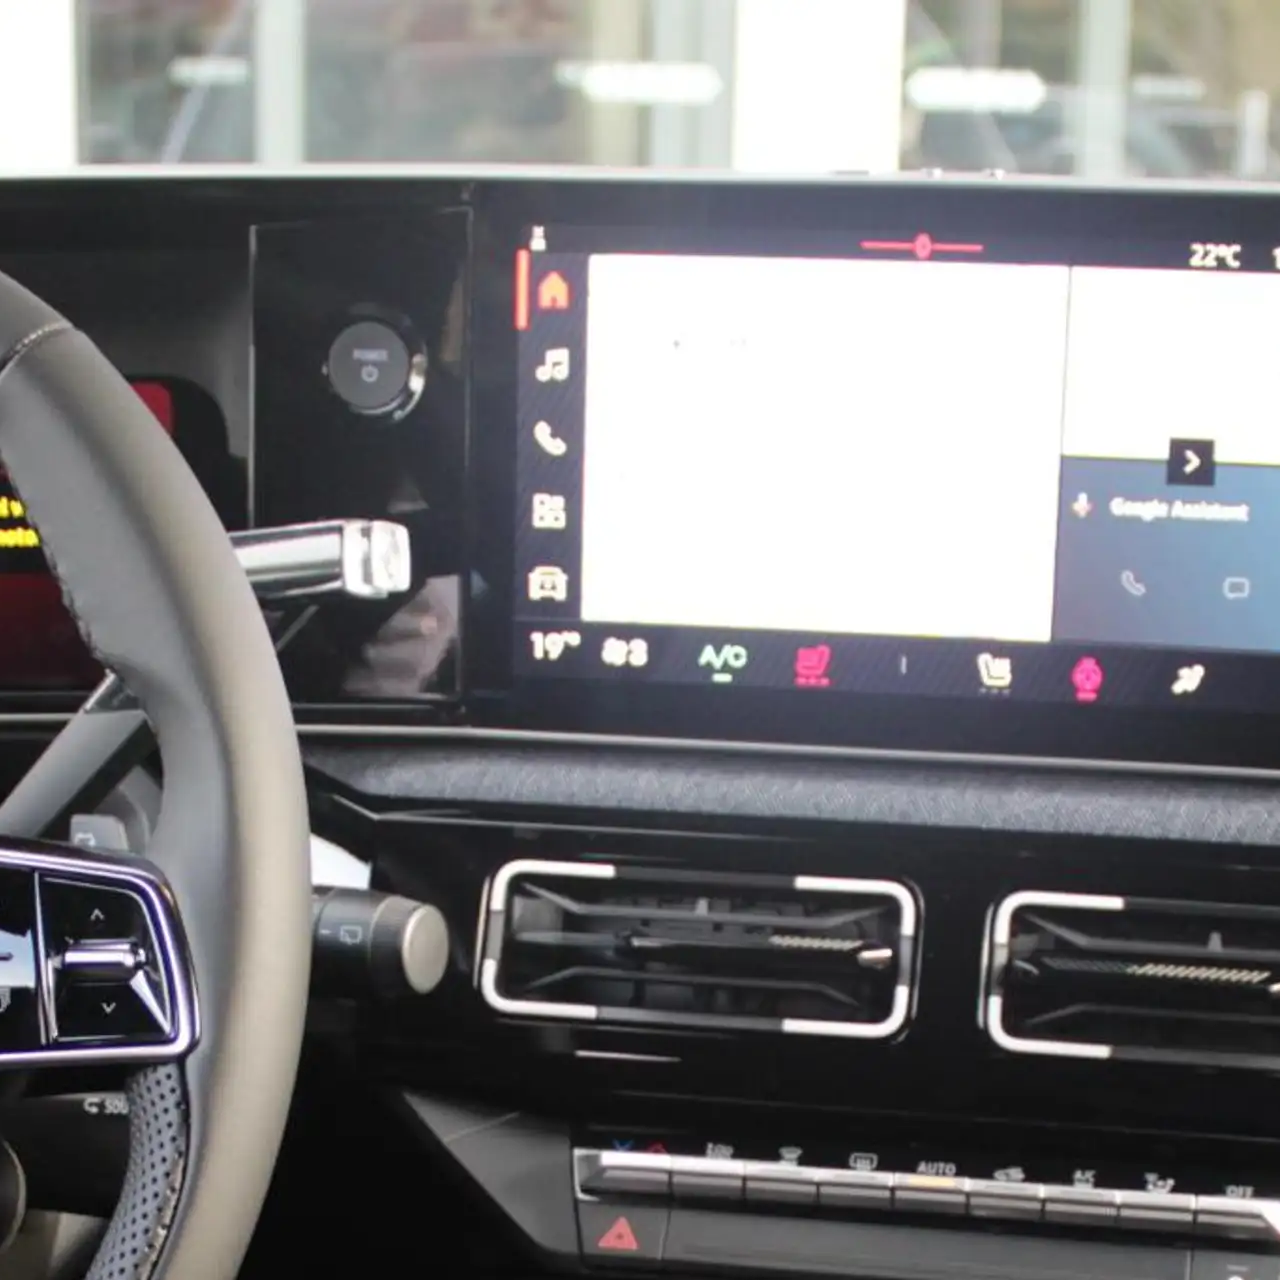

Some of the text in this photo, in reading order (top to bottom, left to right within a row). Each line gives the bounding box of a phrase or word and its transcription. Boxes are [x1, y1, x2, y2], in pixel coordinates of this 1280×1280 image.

[1189, 242, 1241, 268] 22°C
[1109, 497, 1249, 522] Google Assistant
[917, 1160, 956, 1178] AUTO
[1226, 1184, 1254, 1198] OFF
